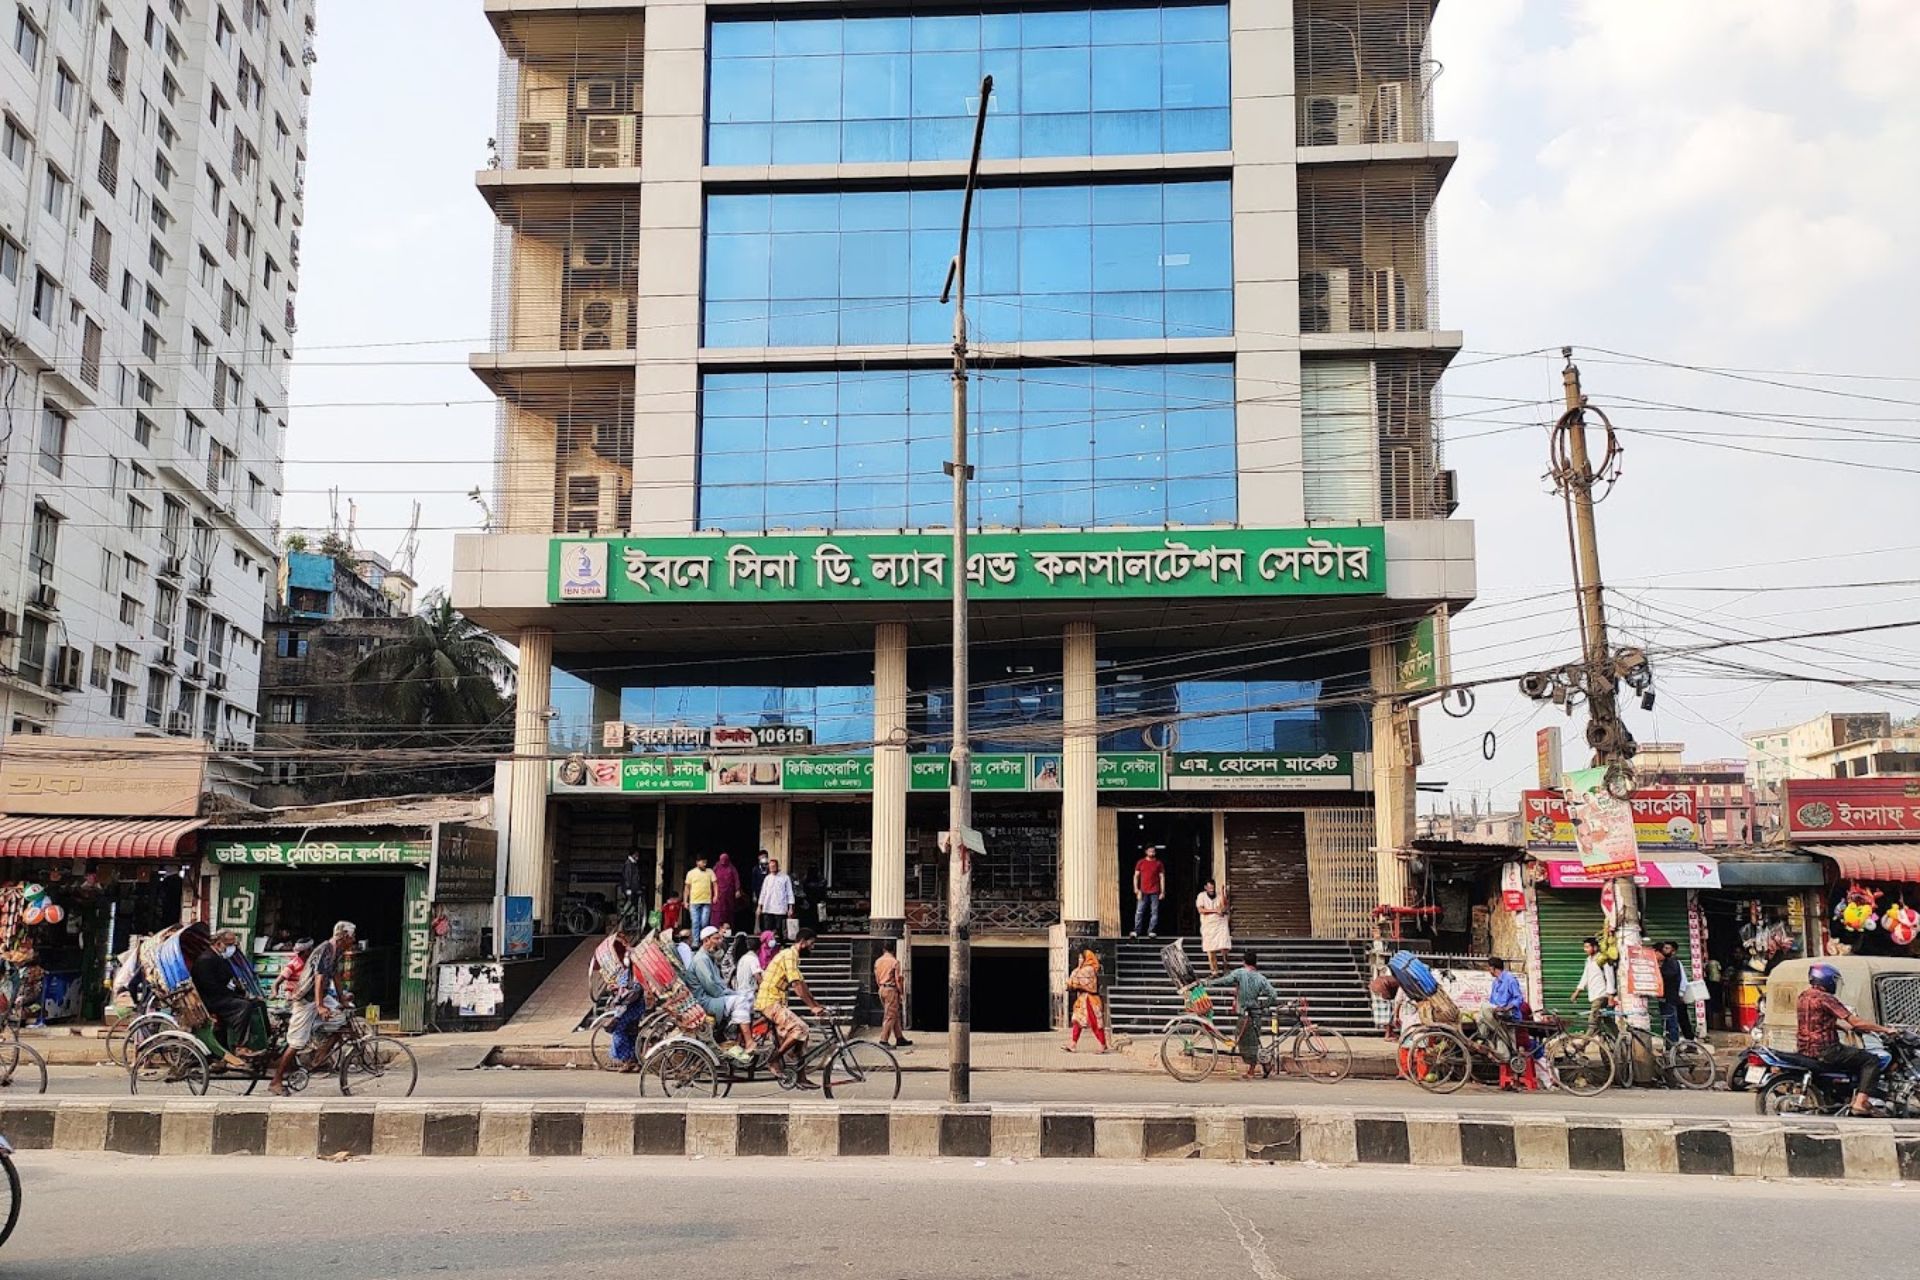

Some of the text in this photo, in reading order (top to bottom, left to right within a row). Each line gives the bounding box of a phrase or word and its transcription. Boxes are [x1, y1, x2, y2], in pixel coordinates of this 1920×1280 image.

[622, 536, 1372, 593] ইবনে সিনা ডি. ল্যাব এন্ড কনসালটেশন সেন্টার
[564, 587, 601, 595] IBN SINA
[758, 728, 804, 743] 10615
[785, 760, 860, 776] ফিজিওথেরাপি
[986, 759, 1022, 775] সেন্টার
[1121, 758, 1156, 774] সেন্টার
[1180, 754, 1339, 773] এম. হোসেন মার্কেট
[1630, 792, 1693, 816] ফার্মেসী
[216, 843, 247, 863] ভাই
[251, 843, 284, 863] ভাই
[287, 843, 353, 863] মেডিসিন
